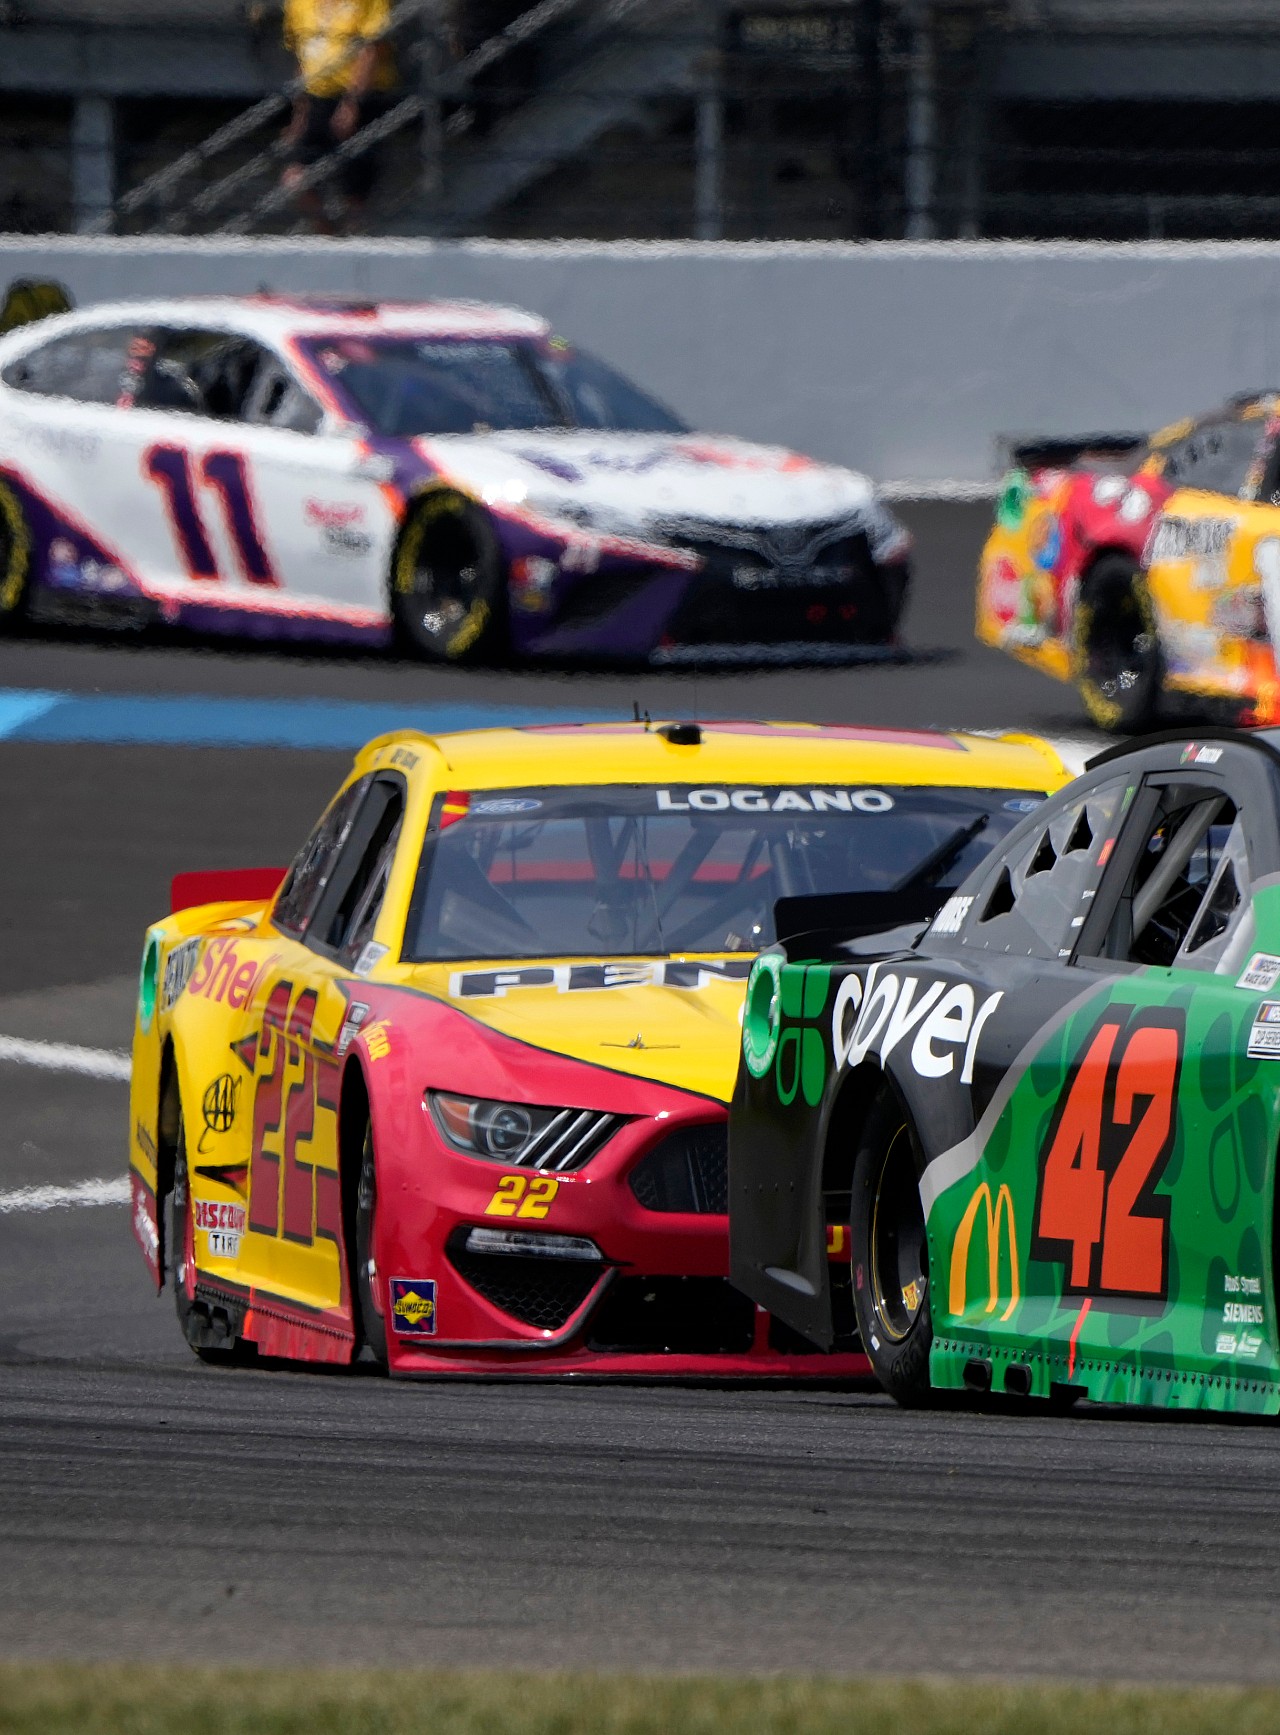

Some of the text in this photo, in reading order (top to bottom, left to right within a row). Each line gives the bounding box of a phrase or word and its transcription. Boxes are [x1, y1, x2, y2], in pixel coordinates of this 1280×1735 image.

[145, 442, 281, 587] 11
[656, 789, 895, 813] LOGANO
[832, 957, 1005, 1085] clover
[247, 979, 319, 1247] 22
[1034, 1014, 1184, 1300] 42
[484, 1175, 560, 1219] 22
[1222, 1301, 1265, 1324] SIEMENS
